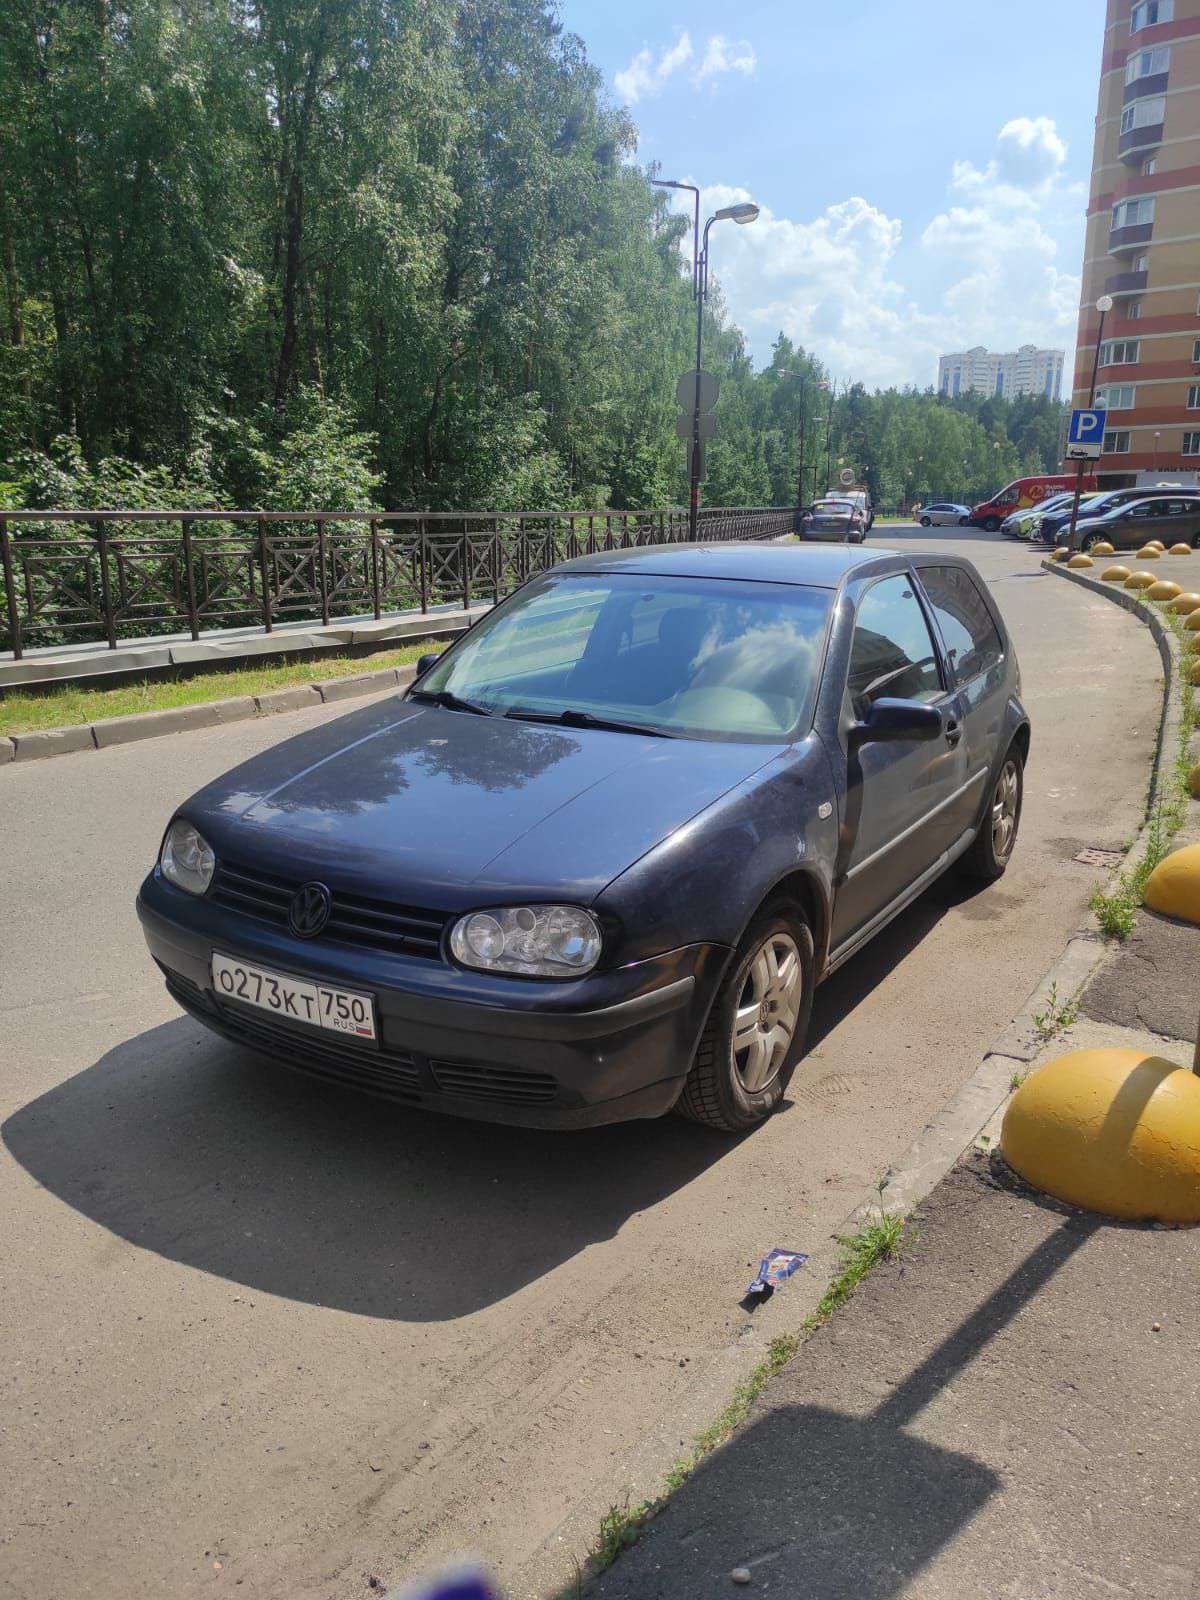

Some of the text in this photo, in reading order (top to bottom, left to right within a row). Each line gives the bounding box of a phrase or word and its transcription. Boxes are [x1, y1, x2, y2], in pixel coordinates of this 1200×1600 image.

[1076, 413, 1098, 440] P
[320, 991, 365, 1023] 750
[333, 1018, 355, 1031] RUS
